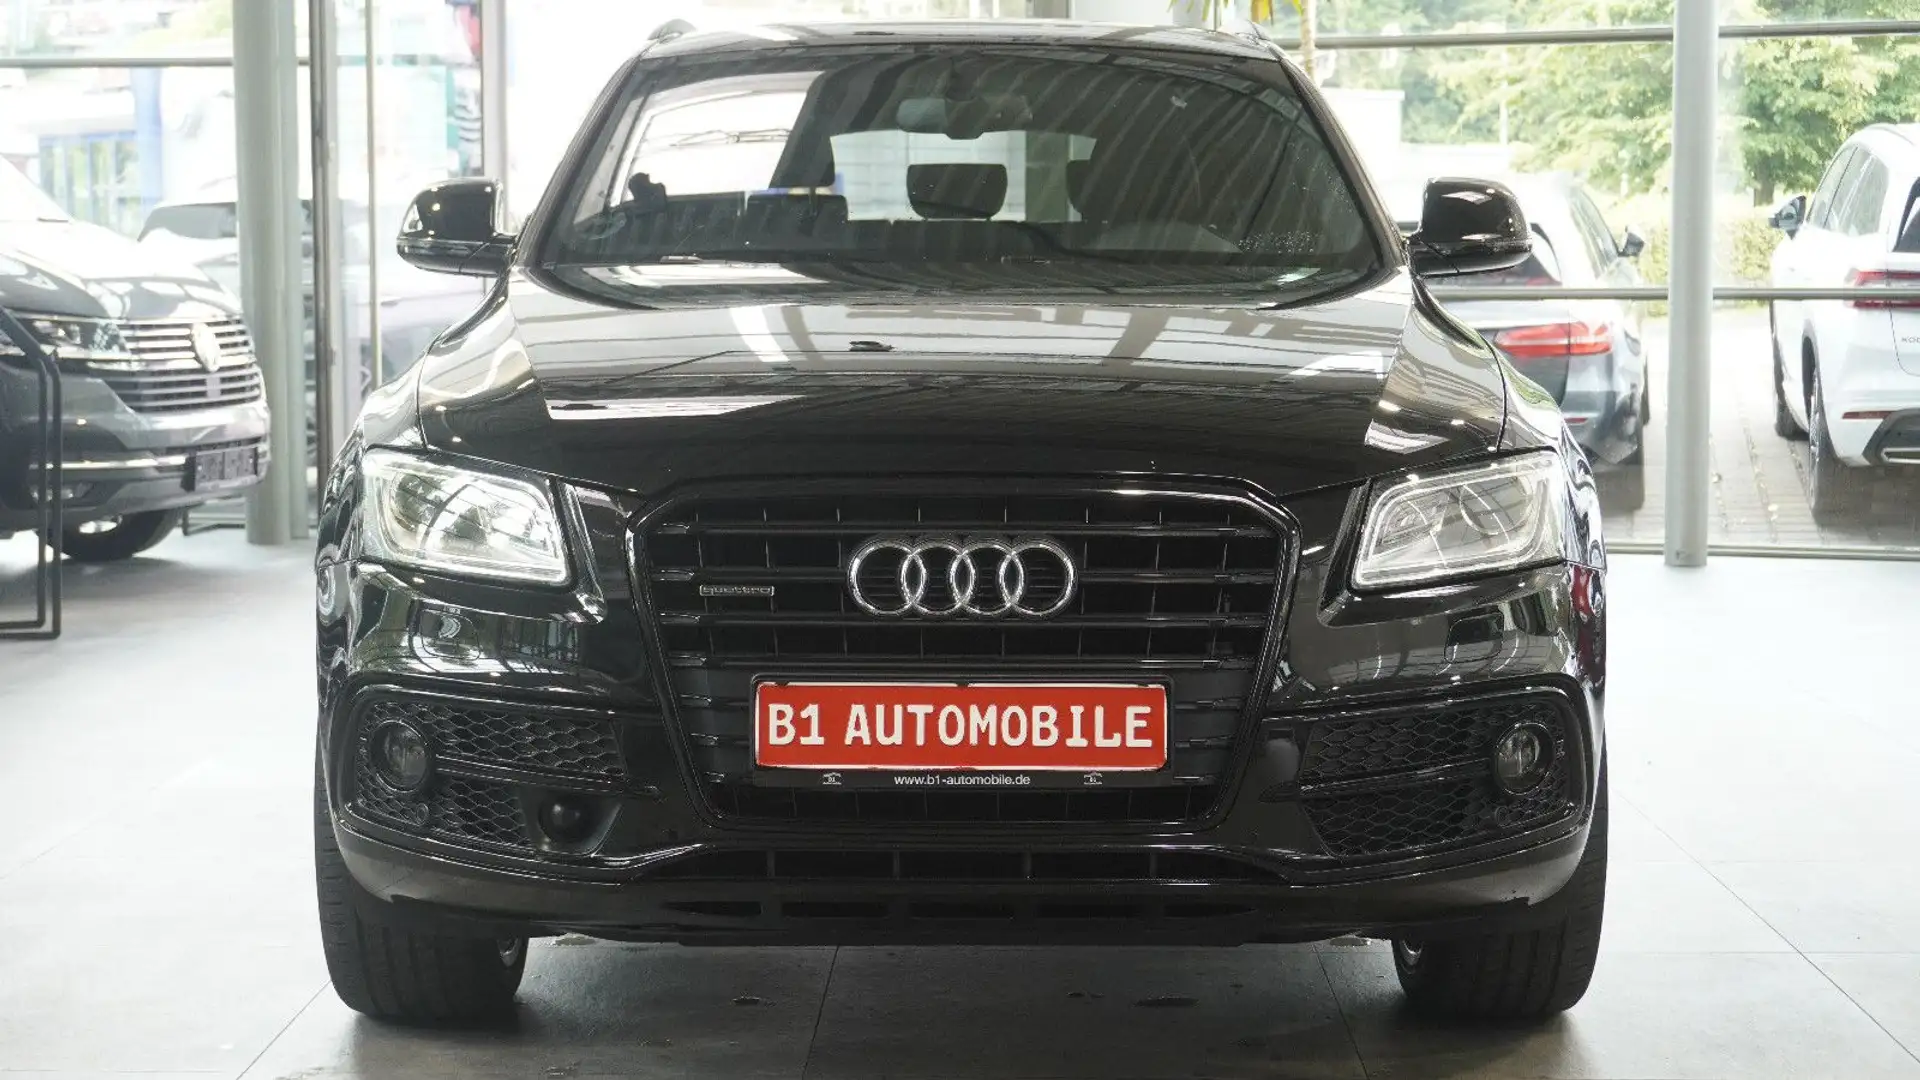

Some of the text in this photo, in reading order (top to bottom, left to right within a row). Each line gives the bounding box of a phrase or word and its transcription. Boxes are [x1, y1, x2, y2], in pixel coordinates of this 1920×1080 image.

[768, 704, 1153, 748] B1 AUTOMOBILE
[894, 774, 1031, 785] www.b1-automobile.de
